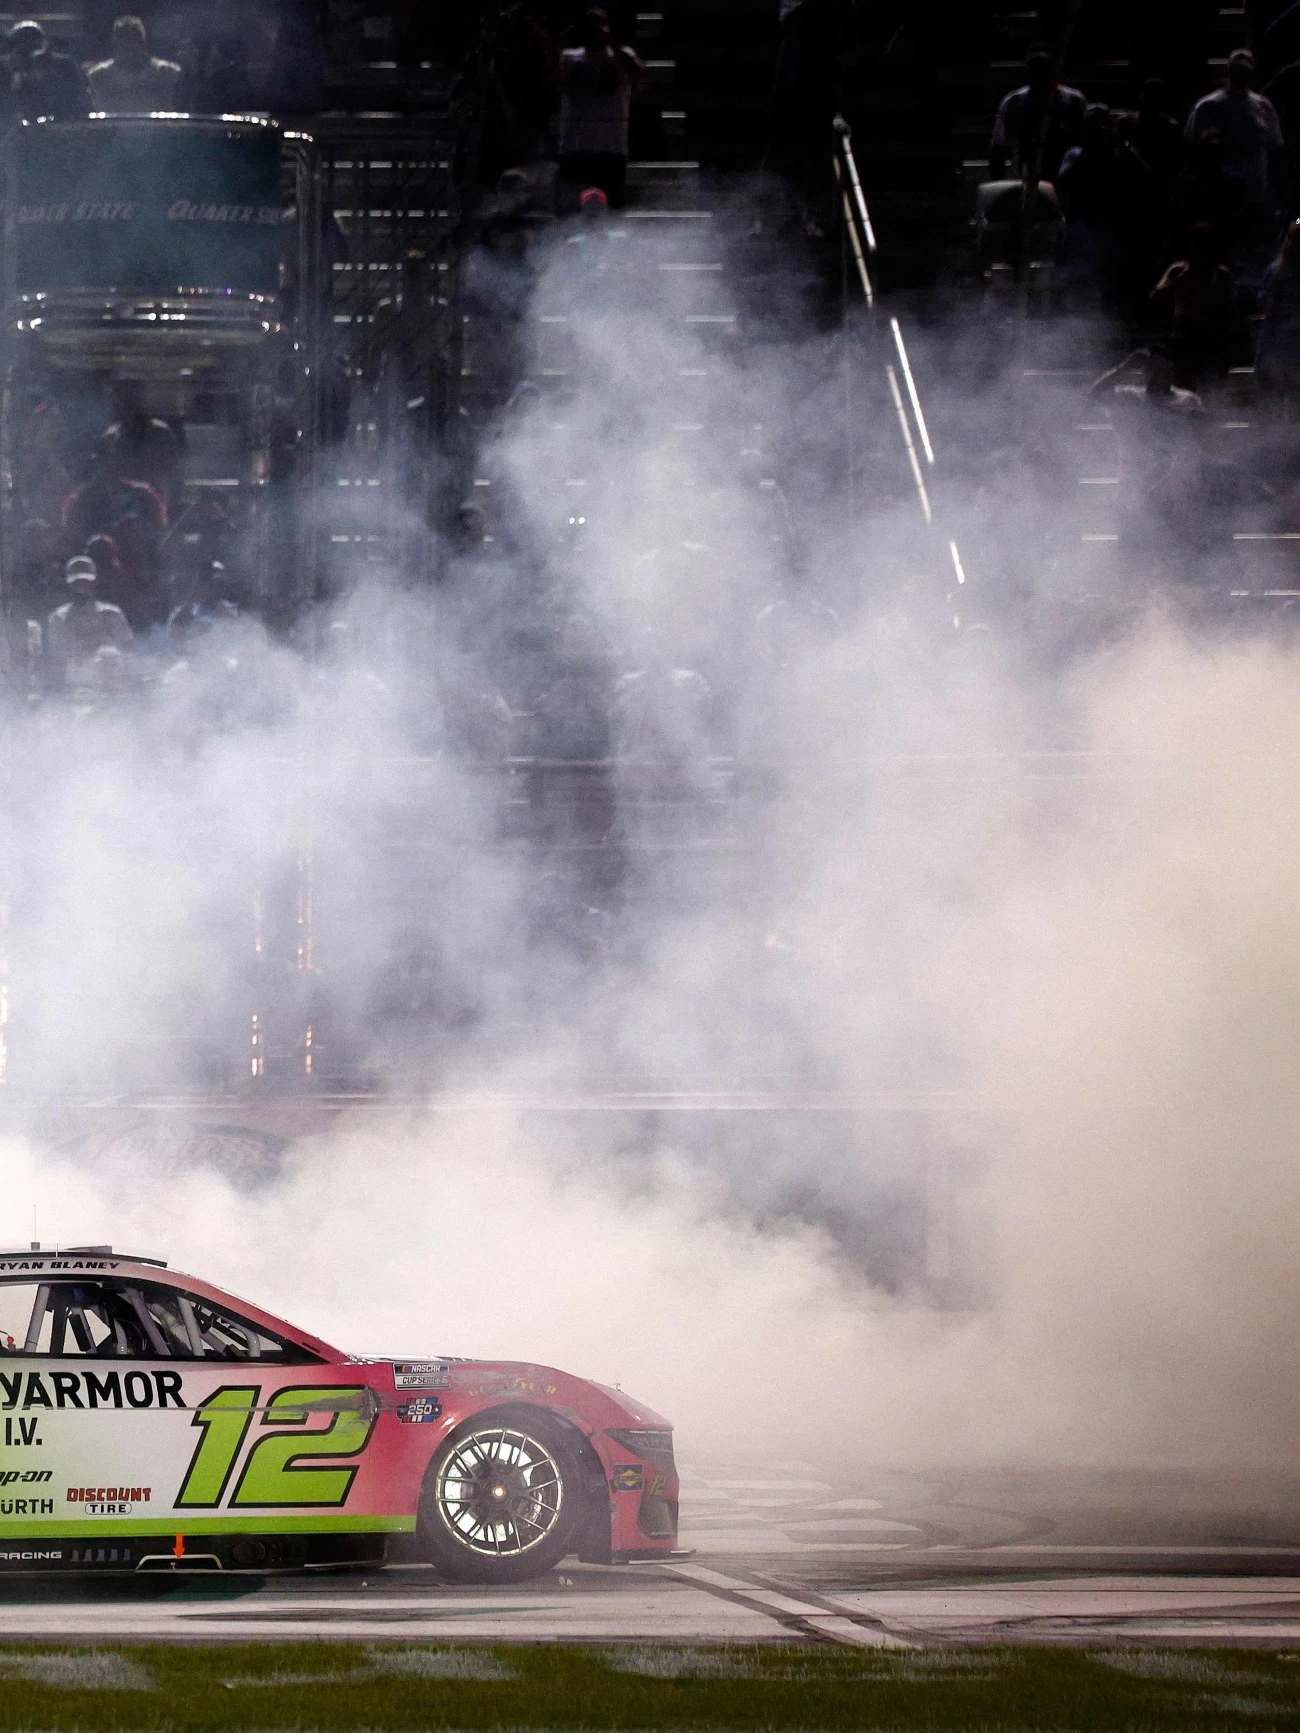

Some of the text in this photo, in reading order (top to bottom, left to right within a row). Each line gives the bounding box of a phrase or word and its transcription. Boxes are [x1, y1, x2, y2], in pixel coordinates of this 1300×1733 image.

[50, 1261, 120, 1269] BLANEY
[411, 1365, 441, 1373] NASCAR
[402, 1376, 442, 1384] CUP SERIES
[408, 1404, 433, 1415] 250
[5, 1417, 43, 1447] I.V.
[172, 1384, 380, 1509] 12
[66, 1487, 152, 1502] DISCOUNT
[89, 1503, 128, 1514] TIRE
